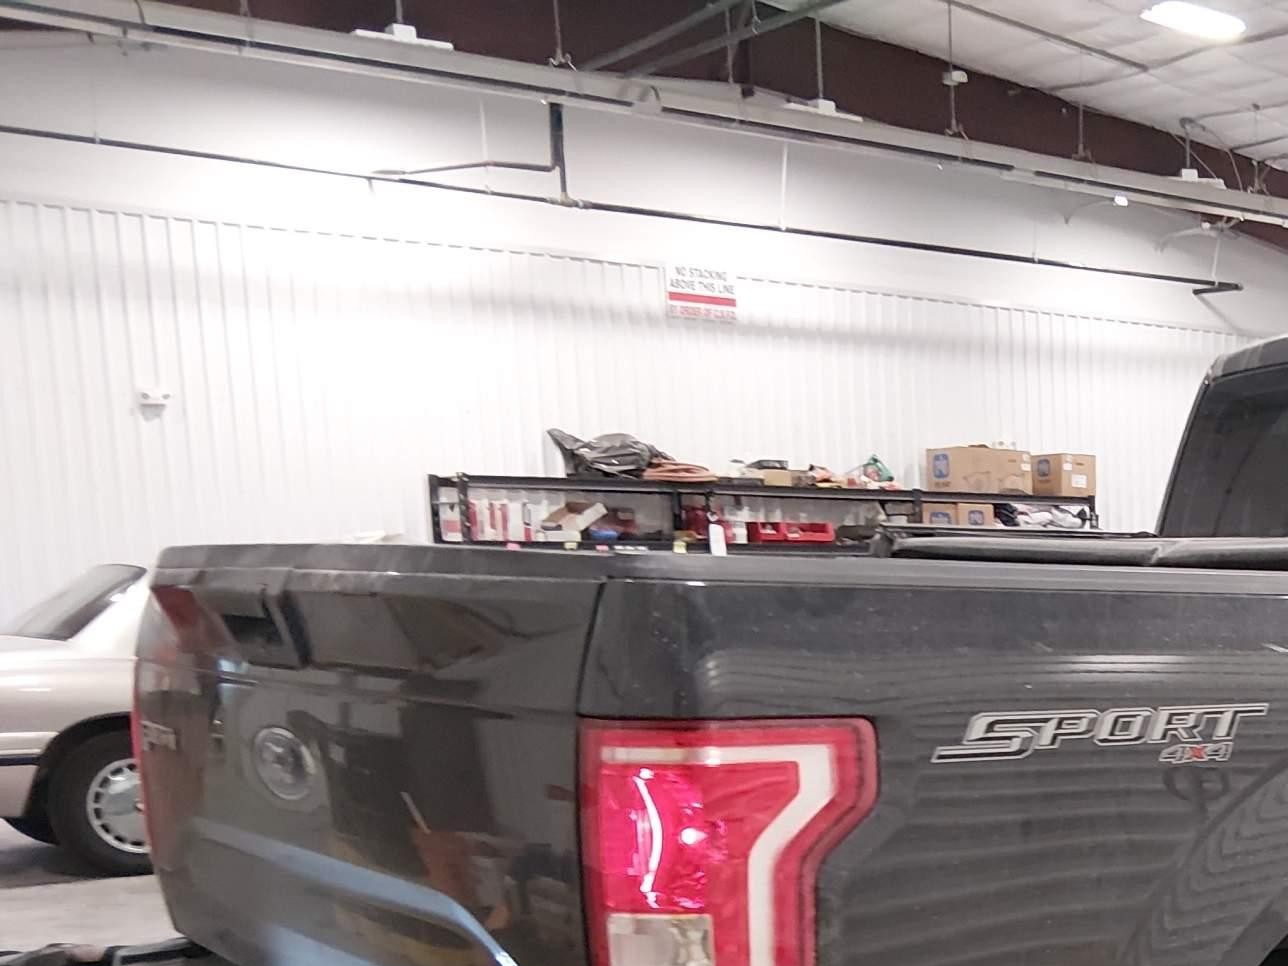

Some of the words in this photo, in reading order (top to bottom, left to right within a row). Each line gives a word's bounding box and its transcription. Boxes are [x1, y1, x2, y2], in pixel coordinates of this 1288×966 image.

[675, 266, 687, 277] NO
[689, 267, 727, 282] STACKING
[669, 278, 696, 291] ABOVE
[698, 281, 715, 293] THIS
[719, 283, 735, 295] LINE
[930, 702, 1269, 764] SPORT
